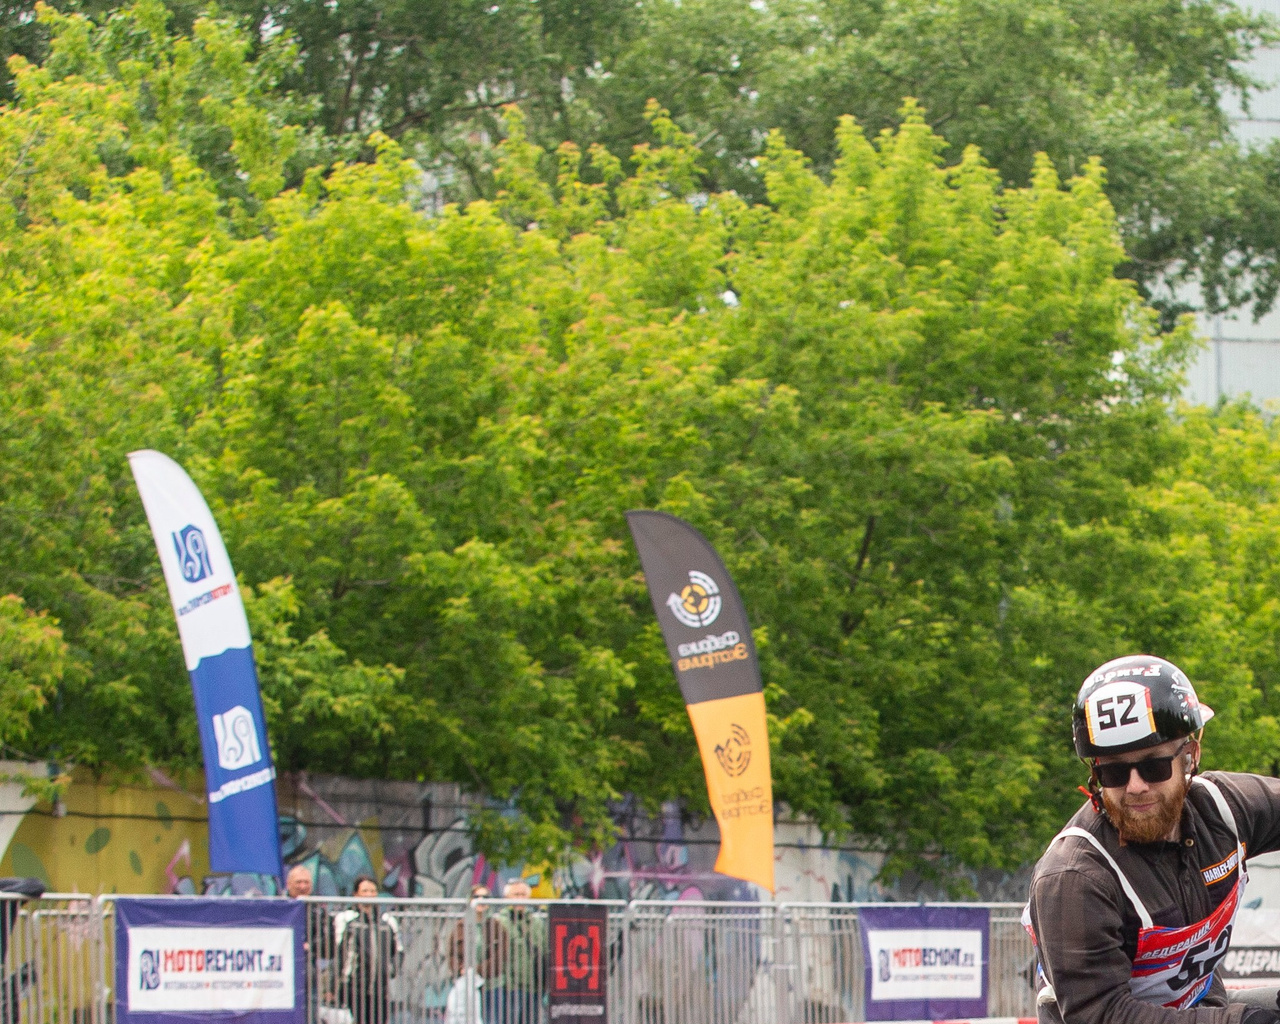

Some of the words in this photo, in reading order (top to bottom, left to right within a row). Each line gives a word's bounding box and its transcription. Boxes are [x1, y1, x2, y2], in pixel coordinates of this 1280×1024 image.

[1096, 693, 1139, 731] 52
[1140, 919, 1211, 960] ФЕДЕРАЦИЯ
[1166, 924, 1233, 991] 52
[163, 949, 282, 973] MOTOREMONT.RU
